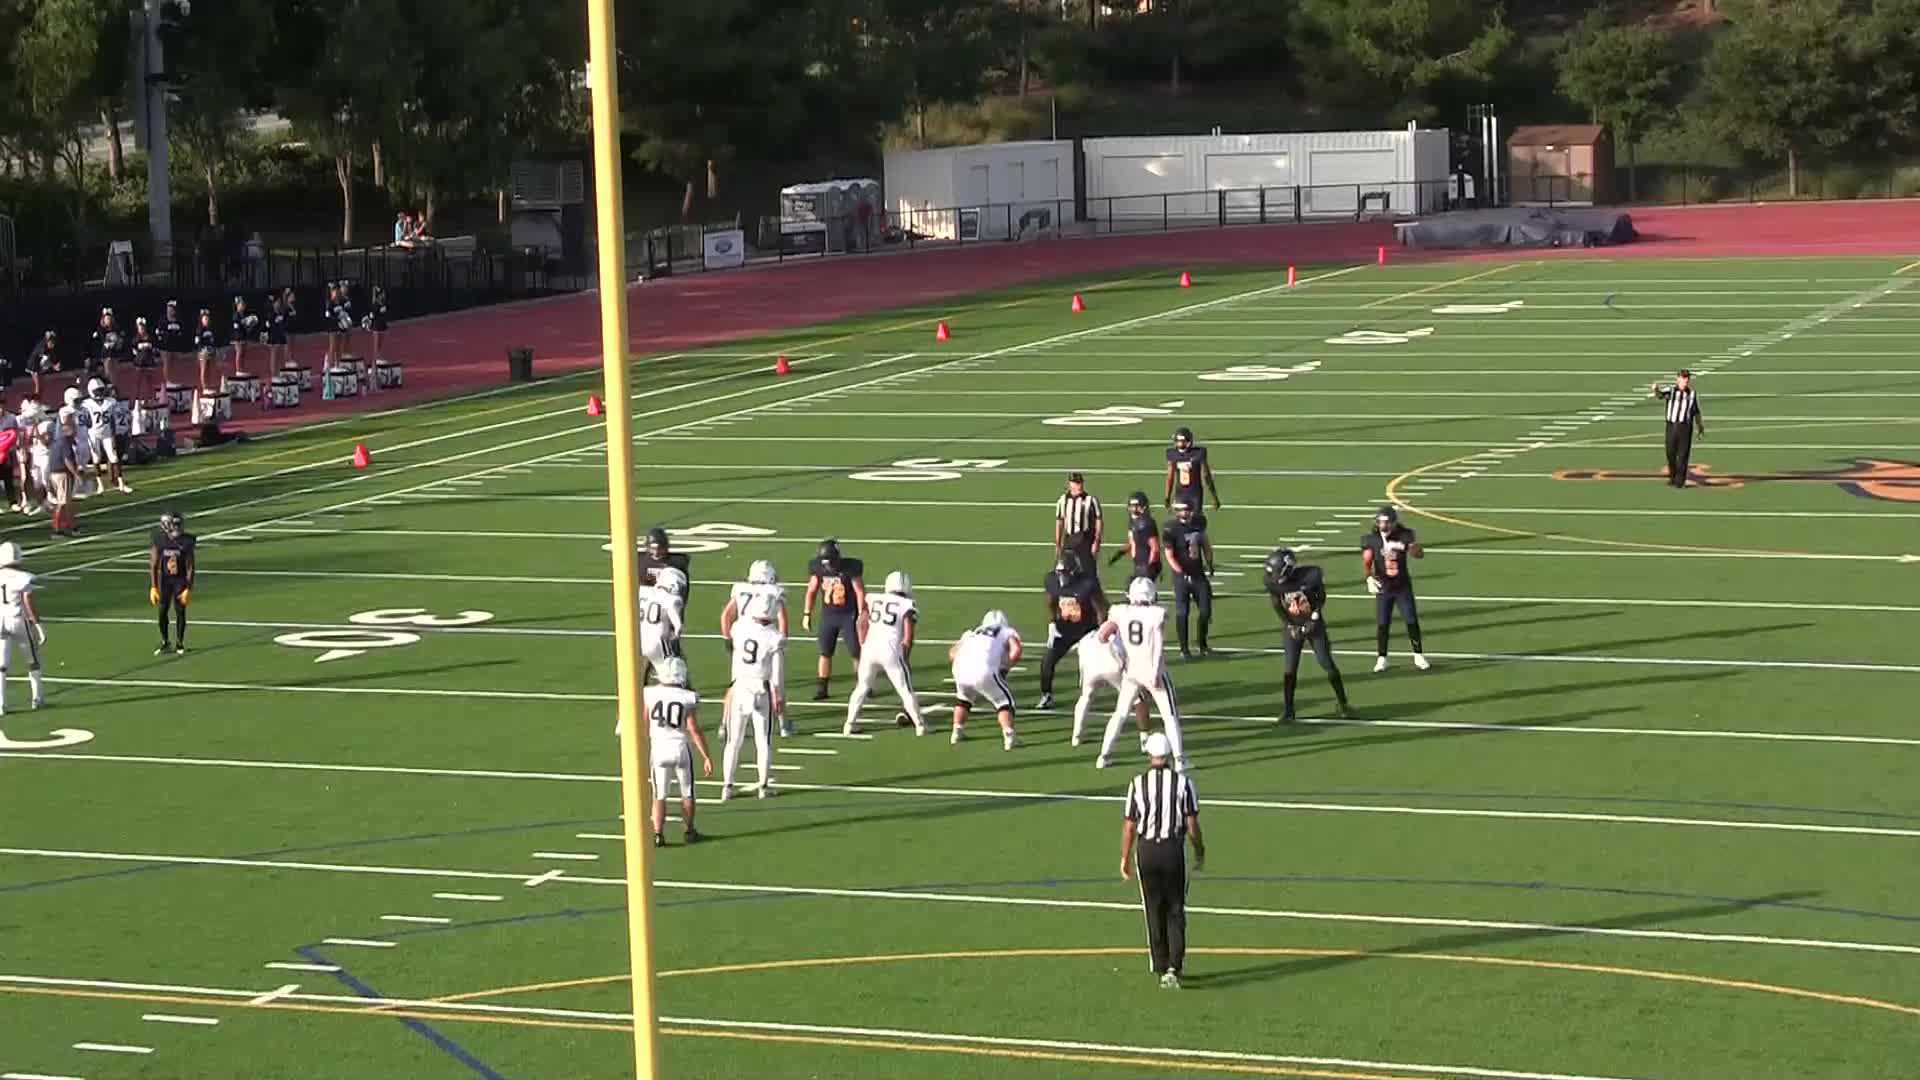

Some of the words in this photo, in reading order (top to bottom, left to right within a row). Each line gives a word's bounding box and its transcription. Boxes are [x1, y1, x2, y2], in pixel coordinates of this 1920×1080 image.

[869, 600, 901, 626] 65
[273, 608, 495, 648] 30
[1127, 619, 1144, 646] 8
[742, 638, 759, 665] 9
[651, 699, 685, 729] 40
